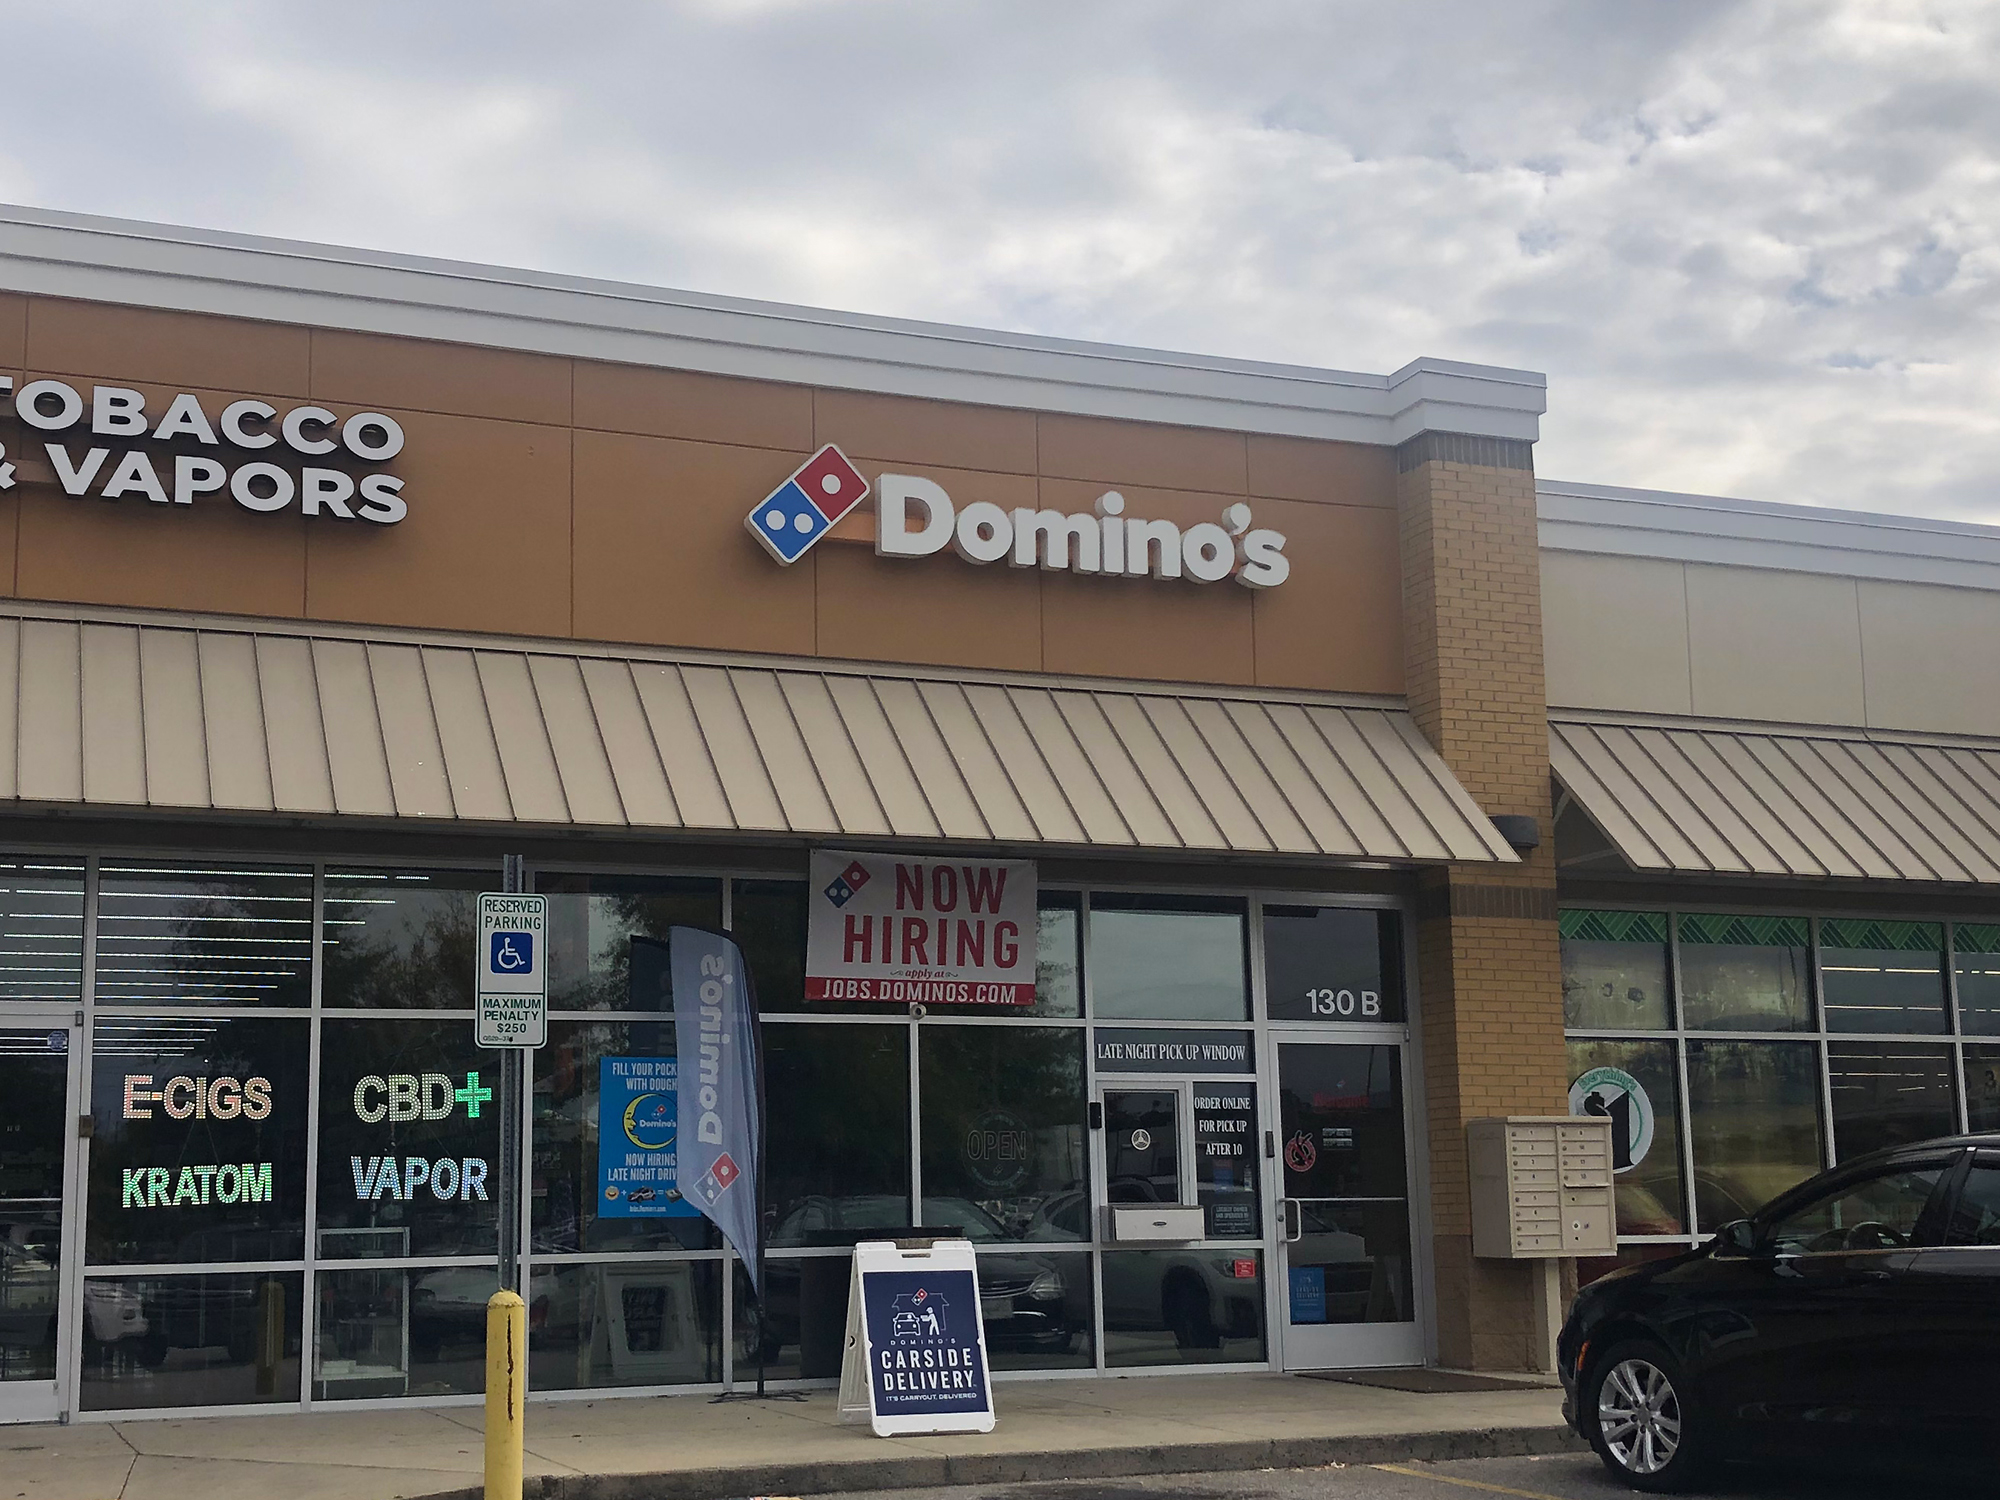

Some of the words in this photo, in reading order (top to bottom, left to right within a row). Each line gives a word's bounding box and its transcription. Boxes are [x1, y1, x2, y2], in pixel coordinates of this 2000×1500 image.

[0, 376, 405, 461] OBACCO
[44, 443, 408, 524] VAPORS
[875, 472, 1290, 589] Domino's
[896, 864, 1008, 914] NOW
[484, 899, 542, 914] RESERVED
[485, 916, 541, 930] PARKING
[843, 915, 1019, 969] HIRING
[905, 968, 932, 979] apply
[822, 979, 1017, 1004] JOBS.DOMINOS.COM
[483, 998, 541, 1009] MAXIMUM
[1306, 988, 1355, 1016] 130
[1361, 990, 1380, 1016] B
[484, 1010, 539, 1021] PENALTY
[497, 1023, 527, 1033] $250
[1098, 1043, 1123, 1059] LATE
[1125, 1043, 1157, 1059] NIGHT
[1159, 1044, 1183, 1060] PICK
[1185, 1044, 1200, 1060] UP
[1202, 1045, 1246, 1061] WINDOW
[612, 1062, 629, 1076] FILL
[631, 1062, 653, 1076] YOUR
[655, 1063, 677, 1076] POCK
[626, 1078, 647, 1091] WITH
[649, 1078, 677, 1091] DOUGH
[121, 1073, 273, 1121] E-CIGS
[1194, 1097, 1221, 1110] ORDER
[1222, 1097, 1251, 1110] ONLINE
[639, 1118, 677, 1128] Domino's
[1199, 1119, 1216, 1132] FOR
[1216, 1120, 1235, 1132] PICK
[1236, 1120, 1247, 1132] UP
[966, 1130, 1027, 1160] OPEN
[1205, 1143, 1231, 1155] AFTER
[1233, 1143, 1243, 1155] 10
[625, 1153, 645, 1166] NOW
[647, 1153, 677, 1166] HIRING
[350, 1155, 490, 1202] VAPOR
[608, 1168, 628, 1182] LATE
[630, 1168, 656, 1181] NIGHT
[657, 1168, 677, 1181] DRIV
[121, 1162, 273, 1209] KRATOM
[890, 1338, 956, 1346] DOMINO'S
[881, 1347, 973, 1369] CARSIDE
[883, 1370, 973, 1391] DELIVERY
